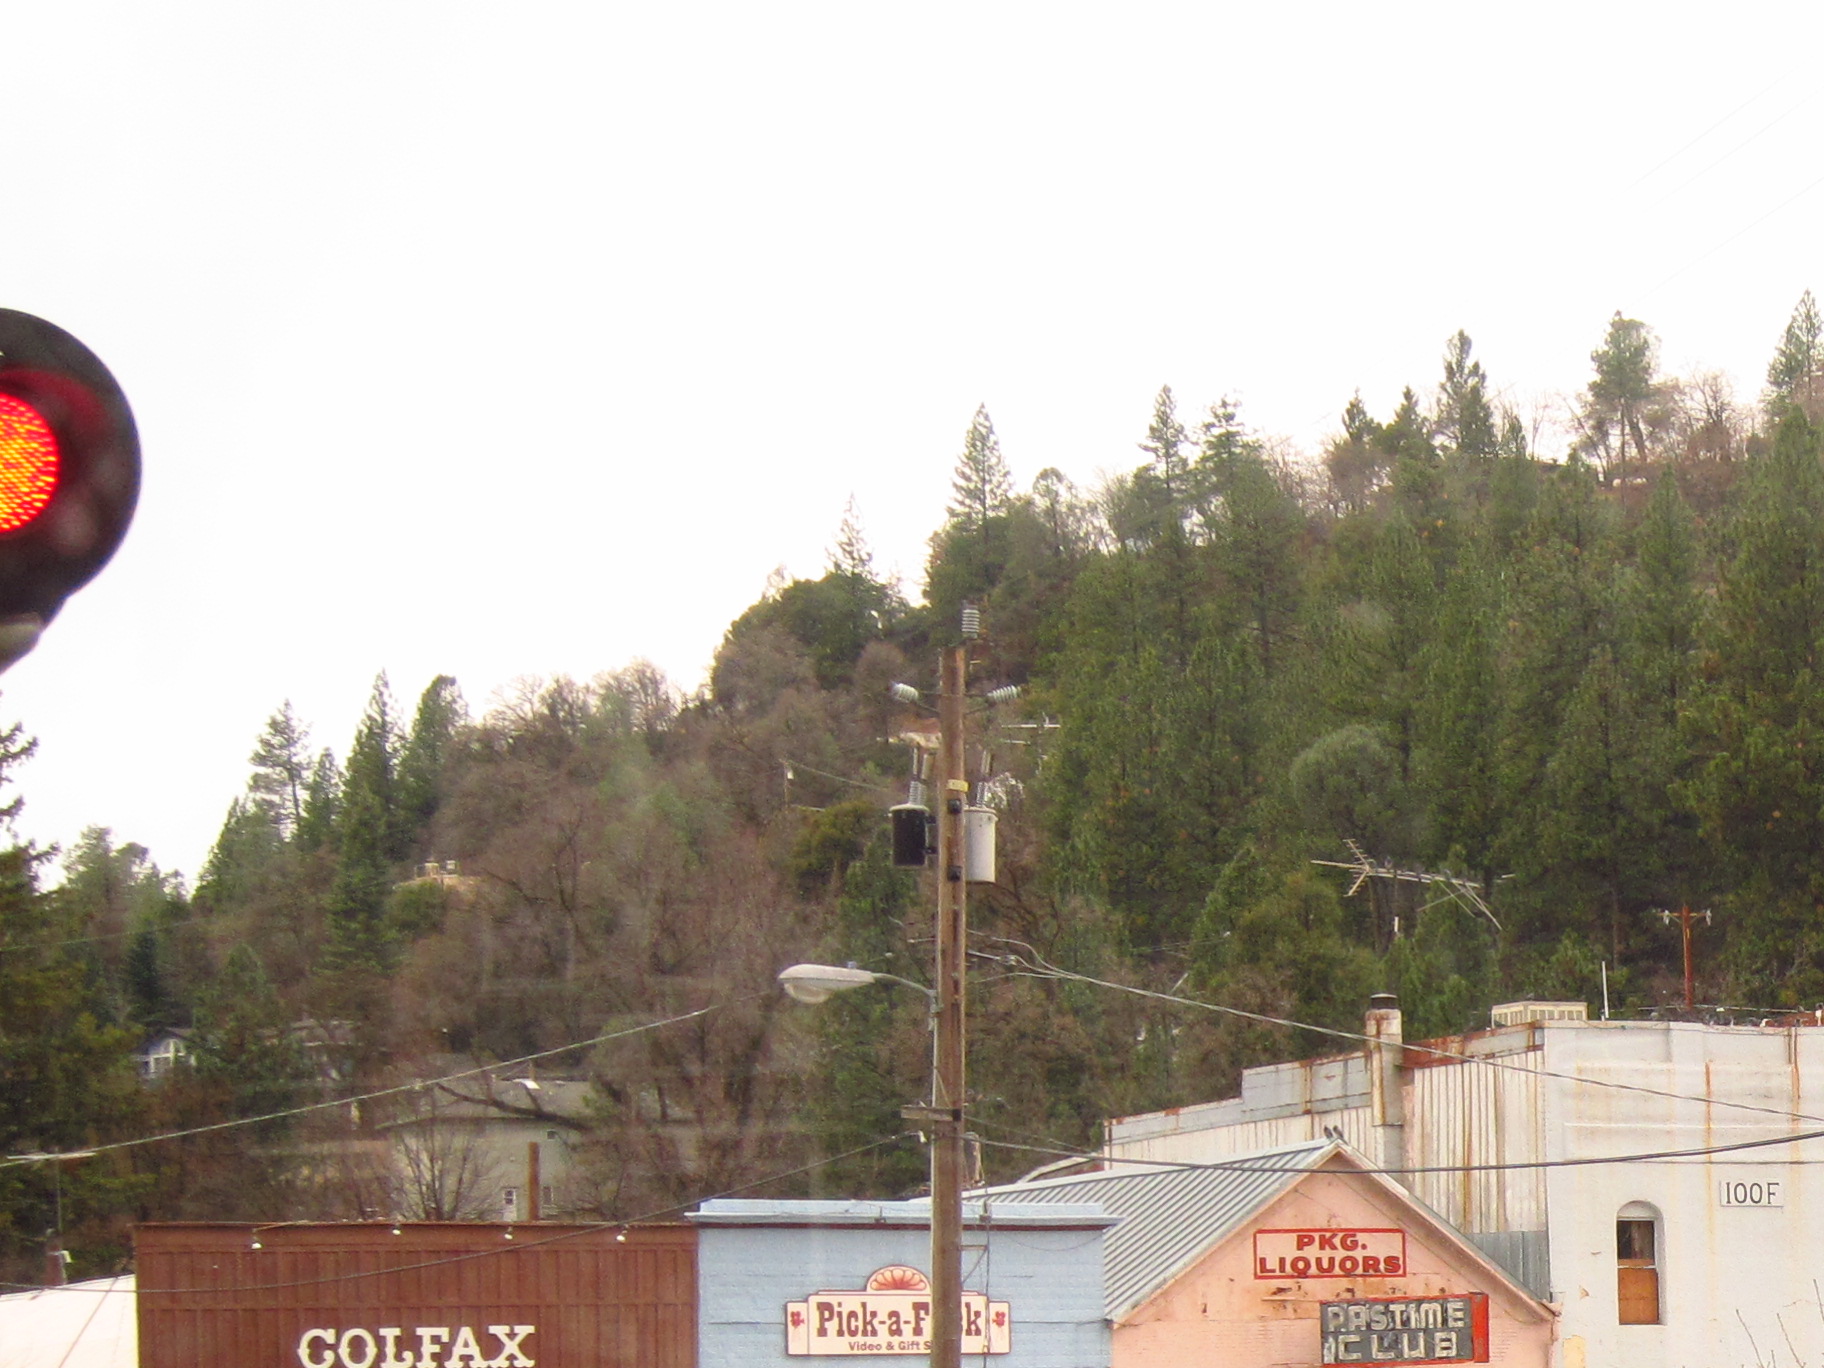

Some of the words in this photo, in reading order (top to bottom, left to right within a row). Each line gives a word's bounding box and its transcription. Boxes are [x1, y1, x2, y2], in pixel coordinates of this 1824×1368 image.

[1296, 1233, 1368, 1251] PKG.
[1258, 1256, 1401, 1278] LIQUORS
[815, 1301, 982, 1338] Pick-a-Fk
[1326, 1299, 1465, 1332] PASTIME
[848, 1341, 883, 1352] Video
[885, 1341, 896, 1352] &
[898, 1341, 921, 1352] Gift
[1337, 1331, 1458, 1361] CLUB
